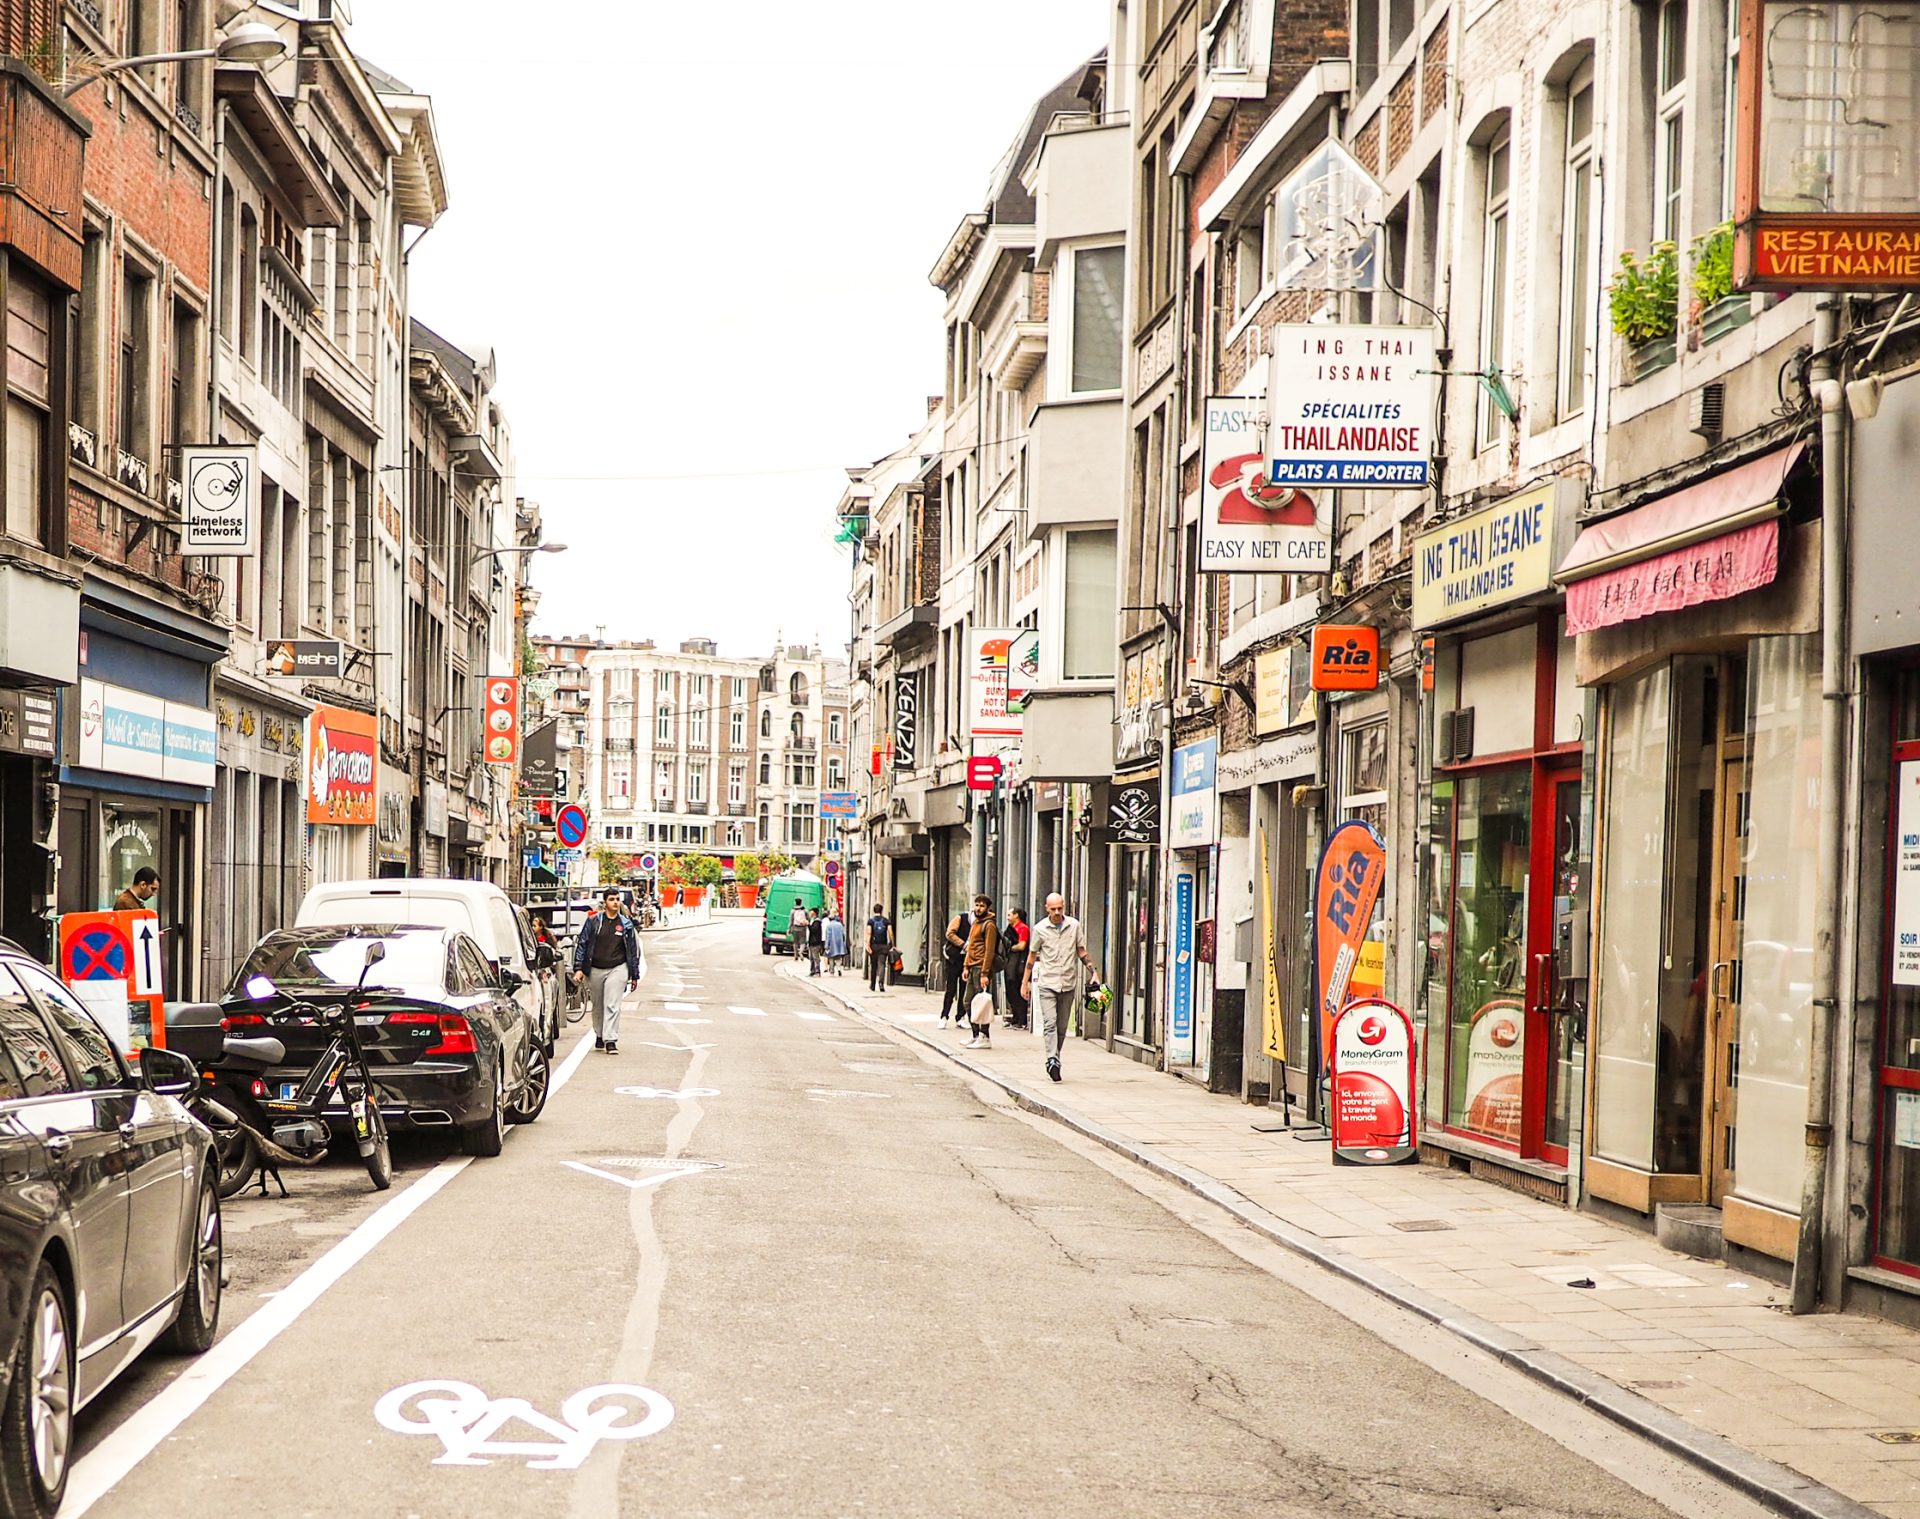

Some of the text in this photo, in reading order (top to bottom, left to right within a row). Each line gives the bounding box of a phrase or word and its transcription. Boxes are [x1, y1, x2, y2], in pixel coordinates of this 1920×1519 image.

[1303, 339, 1413, 356] ING THAI
[1318, 365, 1392, 381] ISSANE
[1301, 398, 1402, 419] SPÉCIALITÉS
[1209, 411, 1252, 432] EASY
[1281, 426, 1420, 452] THAILANDAISE
[1278, 464, 1424, 480] PLATS A EMPORTER
[192, 516, 243, 527] timeless
[192, 526, 242, 537] network
[1206, 540, 1326, 560] EASY NET CAFE
[1422, 543, 1443, 588] ING
[1449, 526, 1484, 574] THAI
[1323, 639, 1372, 665] Ria
[895, 677, 915, 766] KENZA
[1327, 850, 1370, 935] Ria
[1341, 1049, 1404, 1060] MoneyGram
[1341, 1098, 1389, 1107] votre argent
[1348, 1106, 1376, 1114] travers
[1341, 1114, 1378, 1122] le monde
